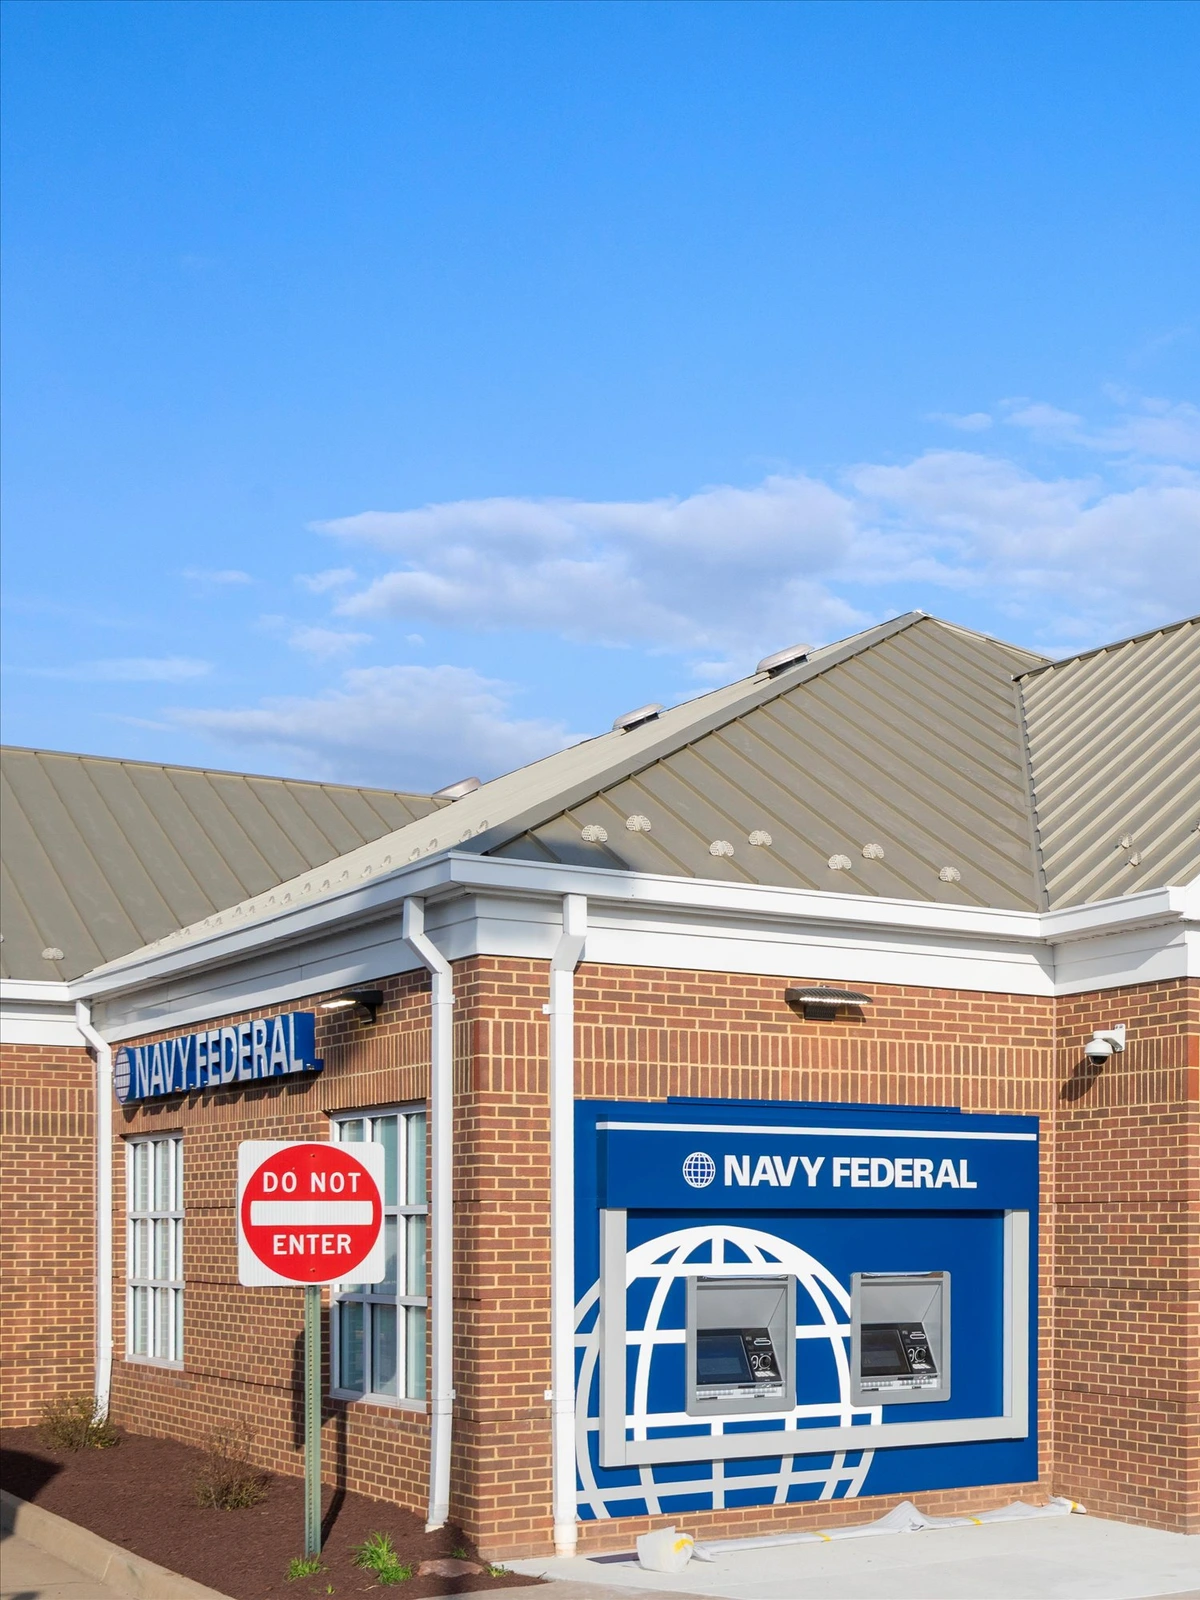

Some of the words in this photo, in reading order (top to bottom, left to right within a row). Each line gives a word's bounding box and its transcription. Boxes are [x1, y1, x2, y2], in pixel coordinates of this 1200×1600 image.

[135, 1034, 191, 1099] NAVY
[195, 1012, 304, 1086] FEDERAL
[262, 1171, 297, 1193] DO
[310, 1172, 362, 1193] NOT
[724, 1155, 825, 1187] NAVY
[832, 1156, 978, 1188] FEDERAL
[272, 1233, 352, 1256] ENTER
